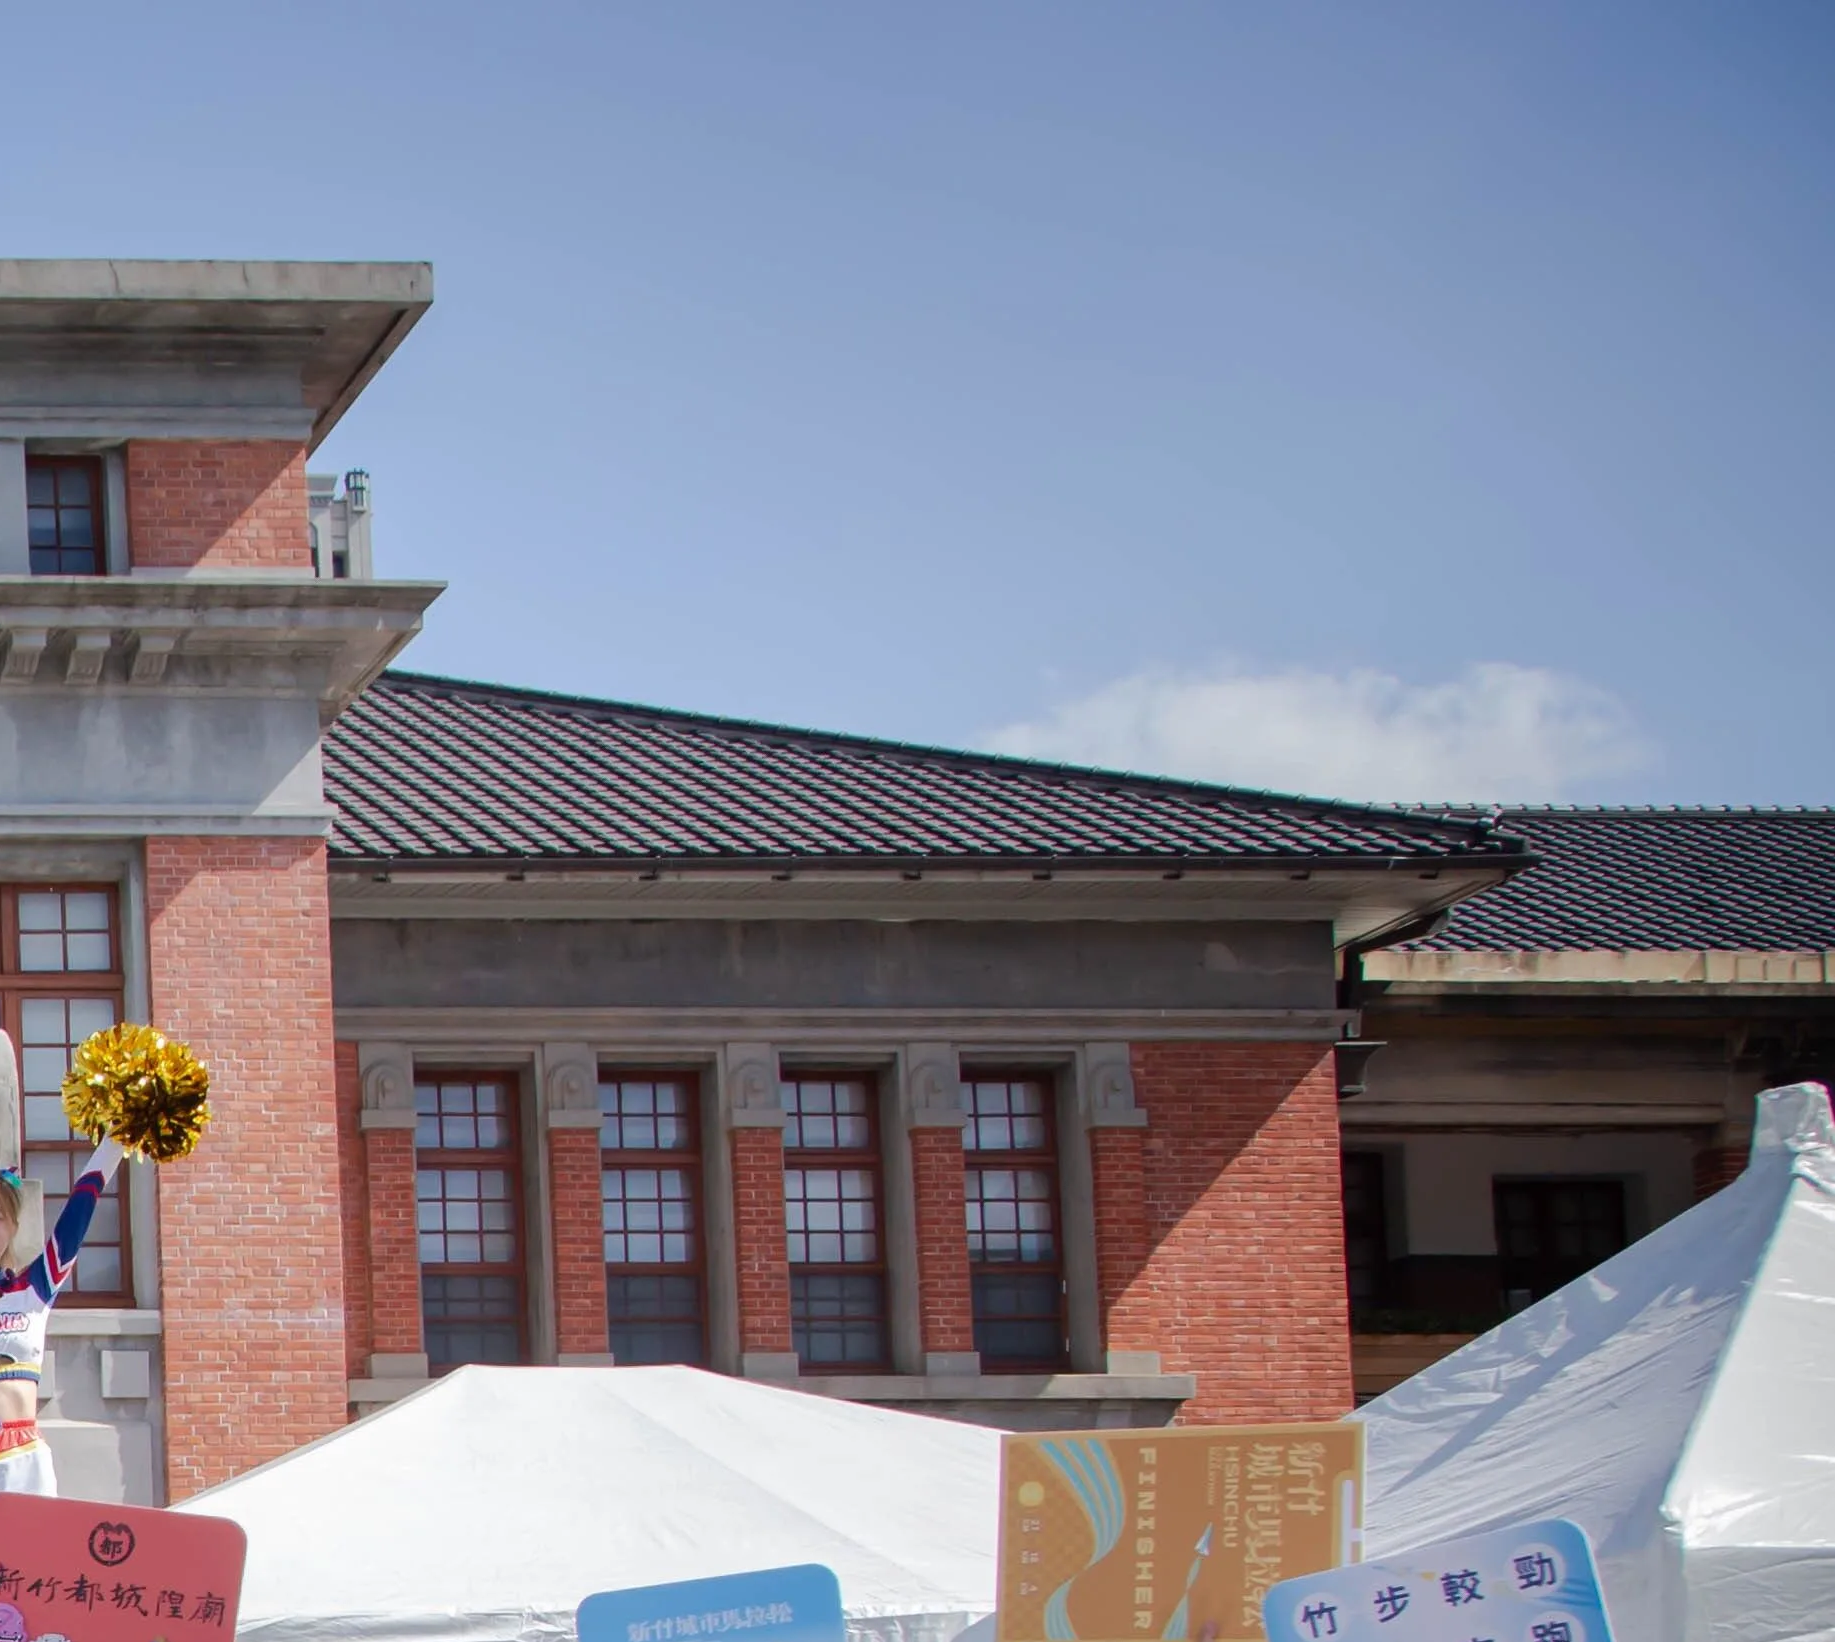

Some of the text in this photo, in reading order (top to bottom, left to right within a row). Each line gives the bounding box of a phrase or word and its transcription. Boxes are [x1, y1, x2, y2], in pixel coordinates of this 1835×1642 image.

[1133, 1446, 1157, 1629] FINISHER
[1223, 1446, 1241, 1548] HSINCHU
[99, 1536, 123, 1560] 都
[1302, 1552, 1557, 1638] 竹步較勁
